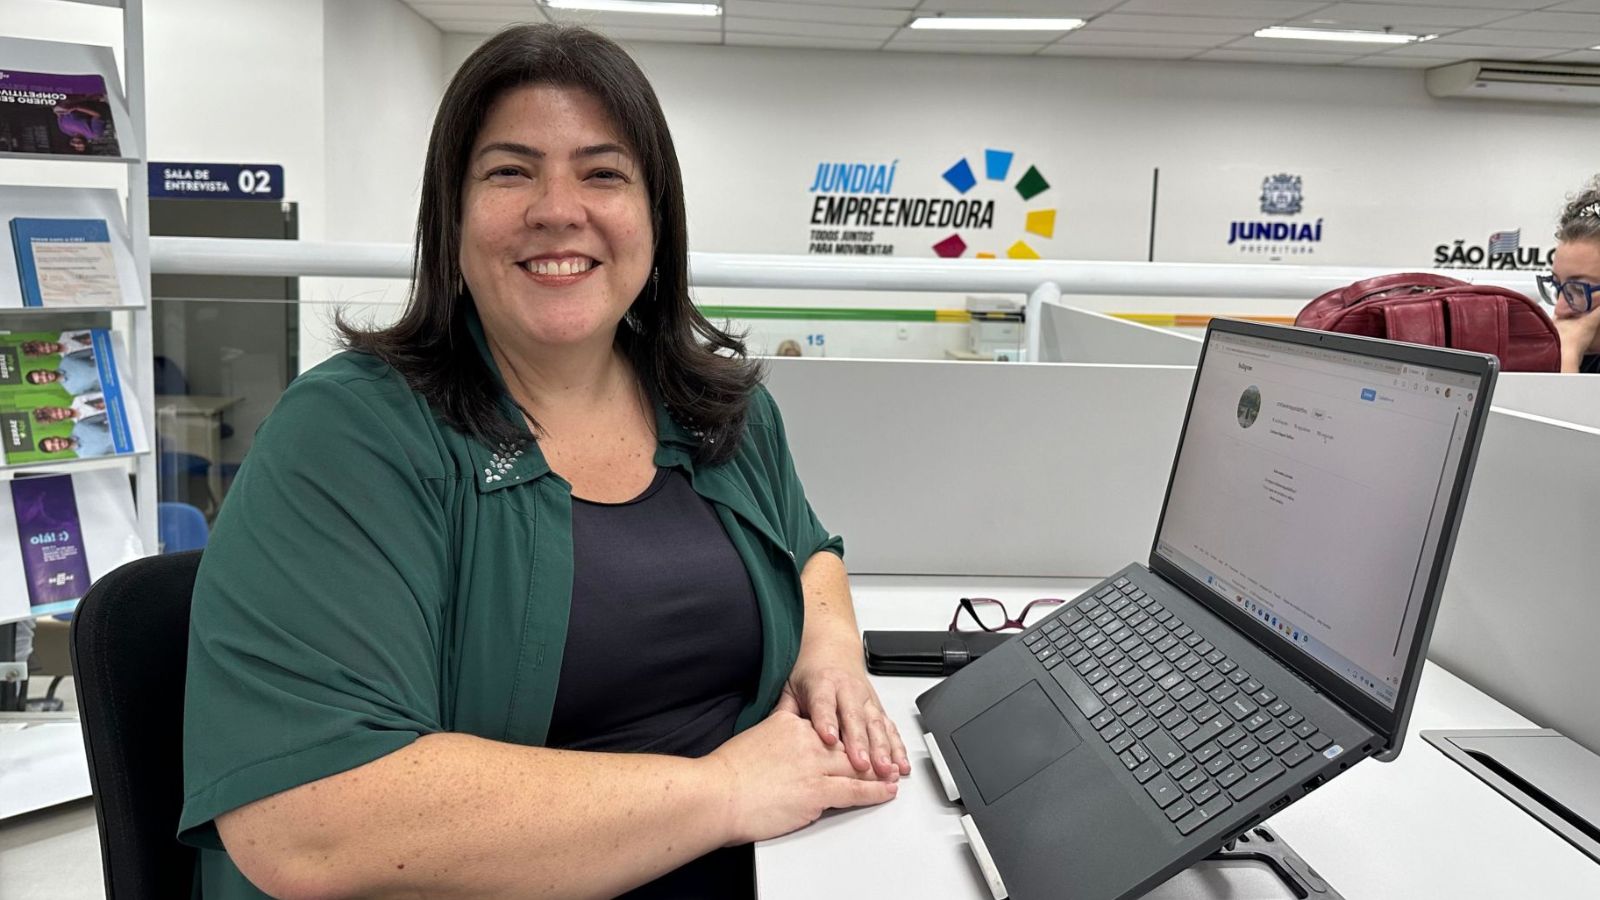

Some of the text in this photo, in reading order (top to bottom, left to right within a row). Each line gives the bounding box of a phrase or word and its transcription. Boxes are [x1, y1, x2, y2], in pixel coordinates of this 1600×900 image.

[0, 89, 67, 101] COMPETITIV
[0, 95, 57, 106] QUERO SE
[164, 168, 210, 180] SALA DE
[809, 159, 899, 194] JUNDIAÍ
[164, 180, 229, 192] ENTREVISTA
[238, 169, 271, 193] 02
[810, 195, 995, 229] EMPREENDEDORA
[810, 229, 874, 242] TODOS JUNTOS
[1227, 217, 1323, 245] JUNDIAÍ
[809, 242, 894, 255] PARA MOVIMENTAR
[1240, 245, 1313, 255] PREFEITURA
[1434, 239, 1484, 265] SÃO
[806, 334, 825, 346] 15
